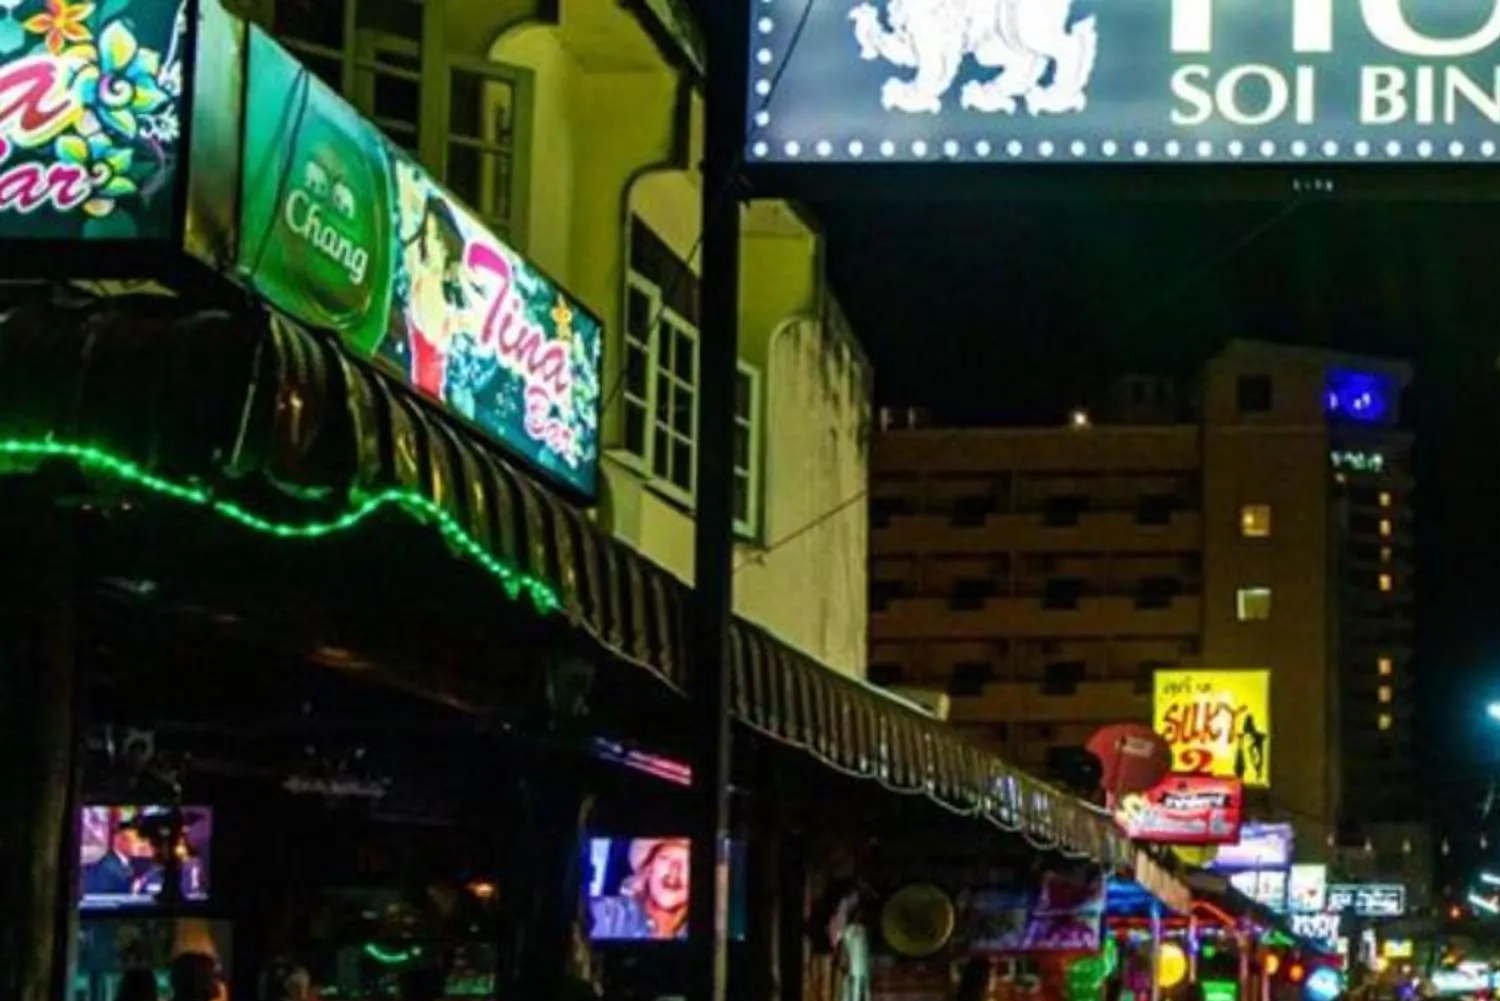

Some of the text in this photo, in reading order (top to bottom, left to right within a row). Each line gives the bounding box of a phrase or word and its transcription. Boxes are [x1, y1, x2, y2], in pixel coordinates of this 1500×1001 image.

[1170, 63, 1315, 125] SOI
[285, 189, 369, 286] Chang
[465, 240, 570, 396] Tina
[1162, 701, 1249, 746] SILKY
